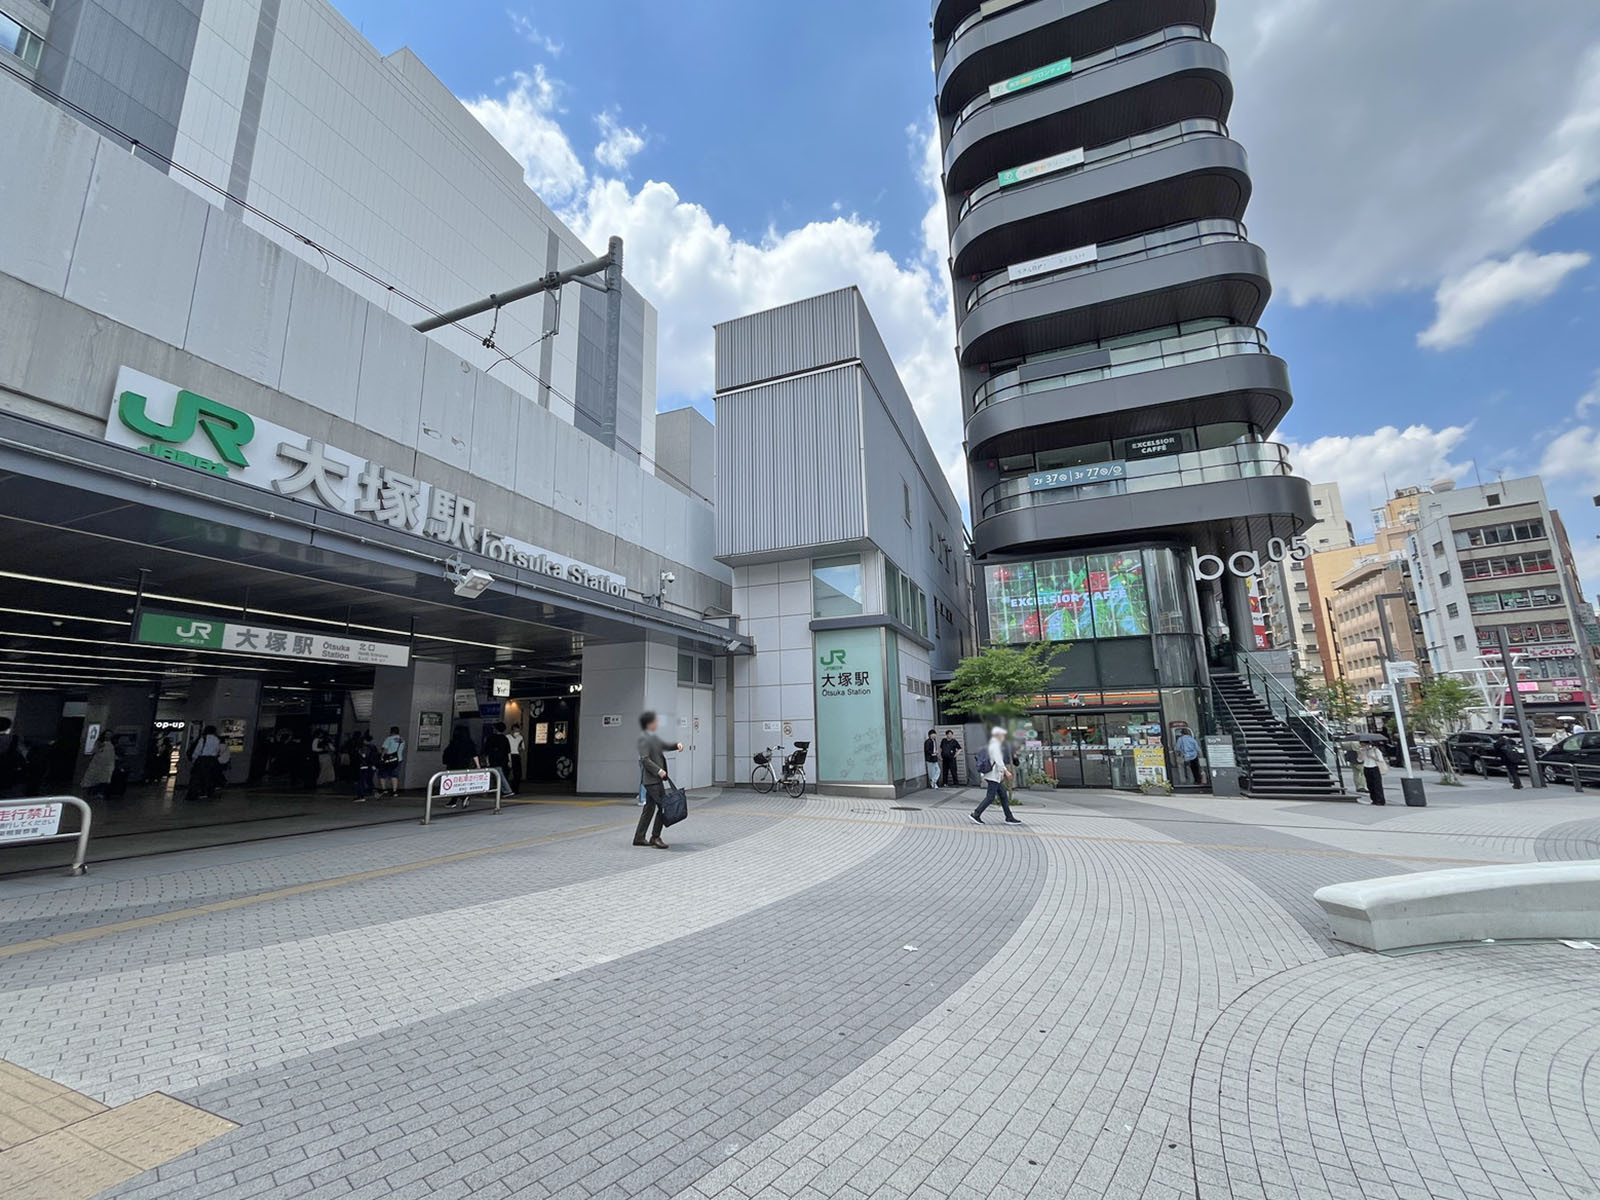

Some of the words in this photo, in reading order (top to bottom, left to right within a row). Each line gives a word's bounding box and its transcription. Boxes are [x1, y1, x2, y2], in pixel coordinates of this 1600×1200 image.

[118, 389, 255, 468] JR
[1131, 437, 1175, 449] EXCELSIOR
[271, 438, 476, 551] 大塚駅
[569, 563, 628, 598] Station
[1010, 590, 1080, 608] EXCELSIOR
[176, 621, 213, 640] JR
[235, 628, 313, 655] 大塚駅
[321, 649, 350, 660] Station
[820, 649, 847, 665] JR
[821, 671, 870, 688] 大塚駅
[847, 688, 871, 696] Station
[153, 720, 185, 729] op-up
